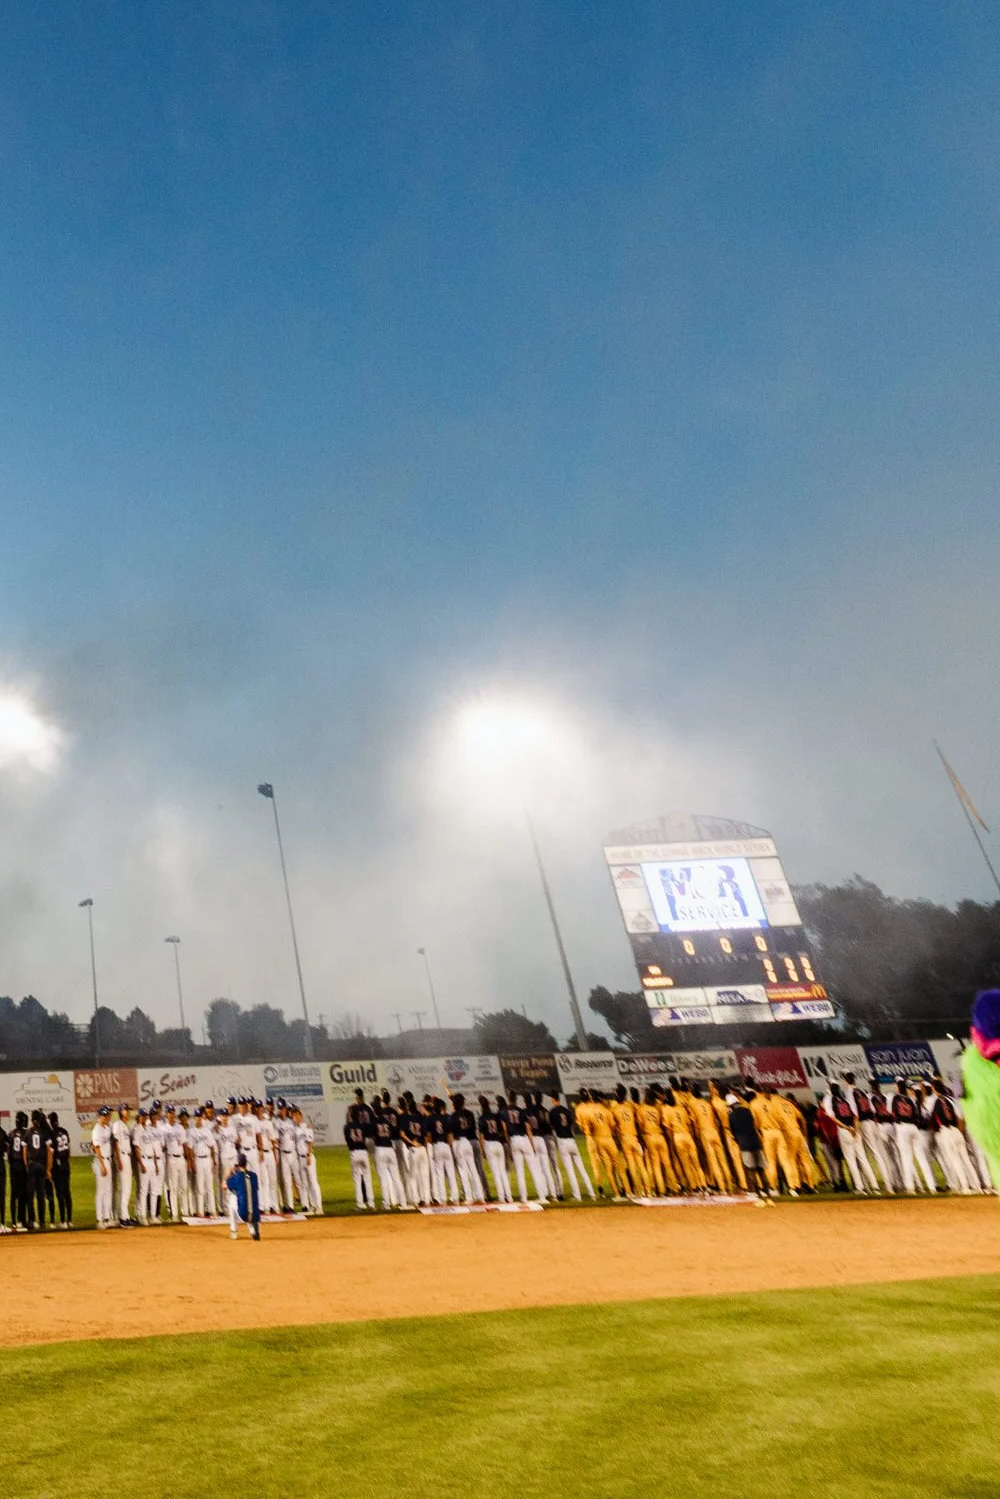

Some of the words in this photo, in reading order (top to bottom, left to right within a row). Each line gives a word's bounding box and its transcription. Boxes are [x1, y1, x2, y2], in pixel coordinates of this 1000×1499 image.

[329, 1063, 378, 1084] Guild
[873, 1061, 936, 1078] PRINTING
[93, 1073, 121, 1093] PMS
